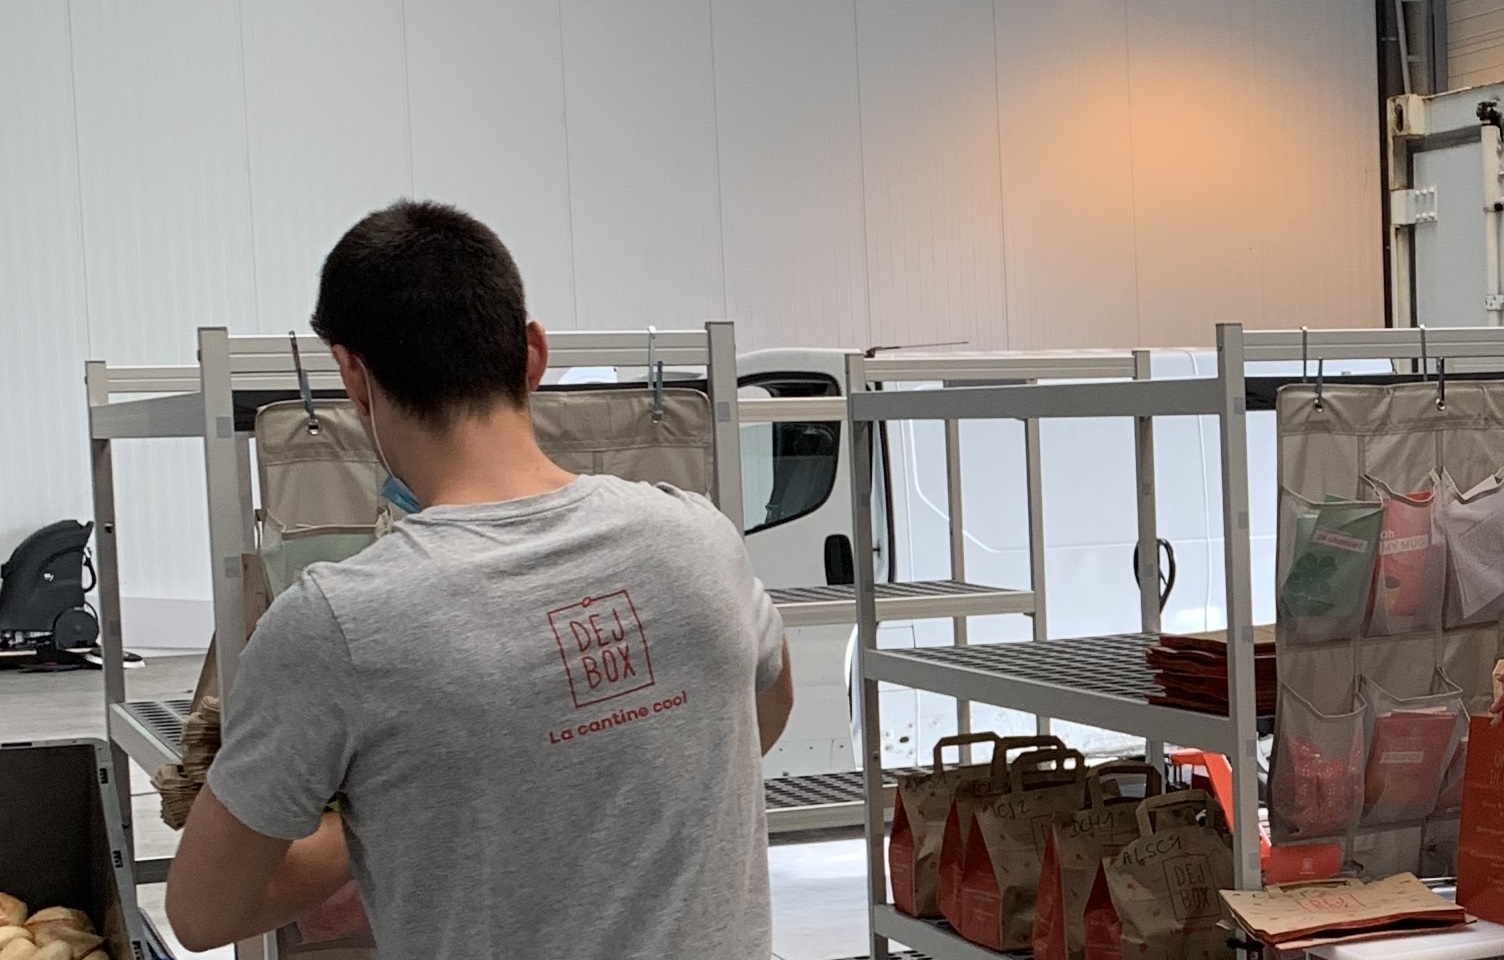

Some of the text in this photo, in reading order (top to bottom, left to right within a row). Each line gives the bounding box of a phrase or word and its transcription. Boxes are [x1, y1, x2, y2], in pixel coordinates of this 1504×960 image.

[568, 607, 626, 653] DEJ
[581, 643, 637, 690] BOX
[548, 690, 689, 745] La cantine cool
[1173, 862, 1206, 887] DEJ
[1178, 886, 1212, 912] BOX
